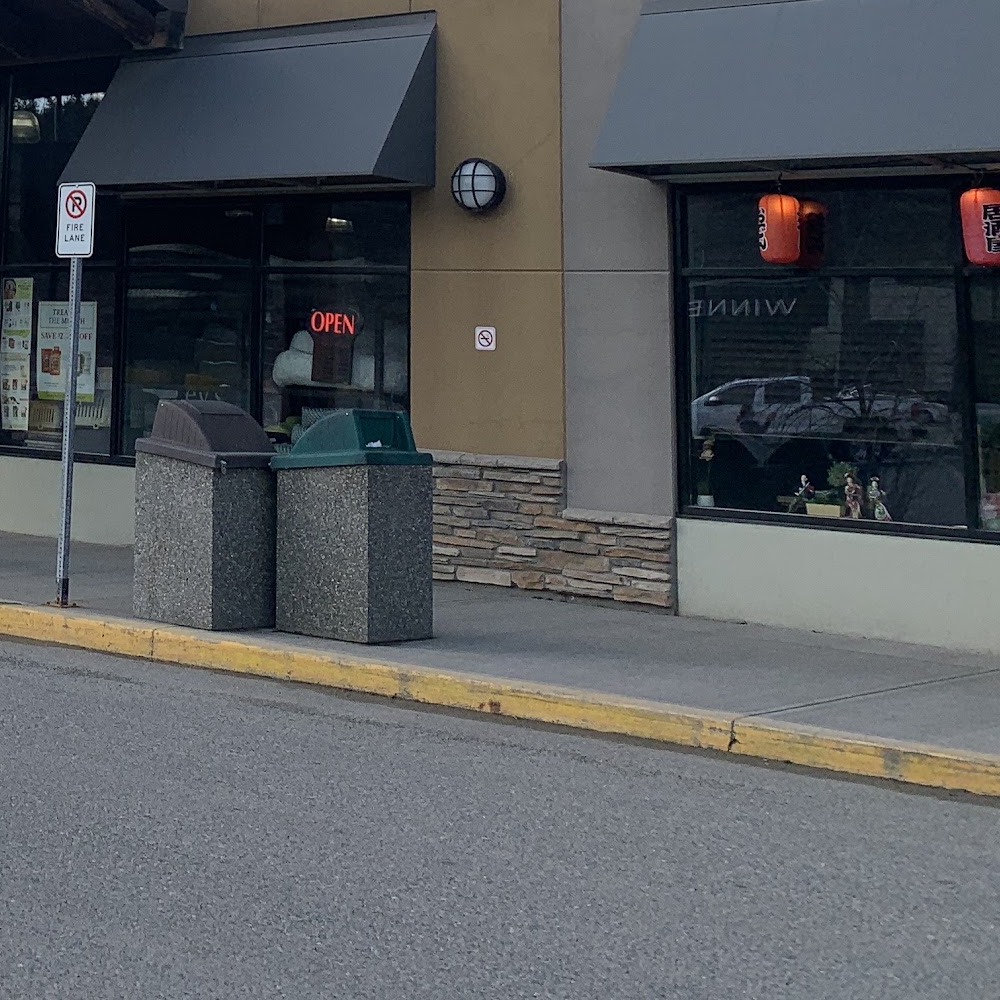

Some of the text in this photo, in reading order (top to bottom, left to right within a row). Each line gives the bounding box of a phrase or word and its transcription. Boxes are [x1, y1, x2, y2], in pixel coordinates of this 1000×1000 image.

[66, 223, 84, 232] FIRE
[64, 234, 86, 242] LANE
[310, 311, 356, 335] OPEN
[41, 332, 57, 340] SAVE
